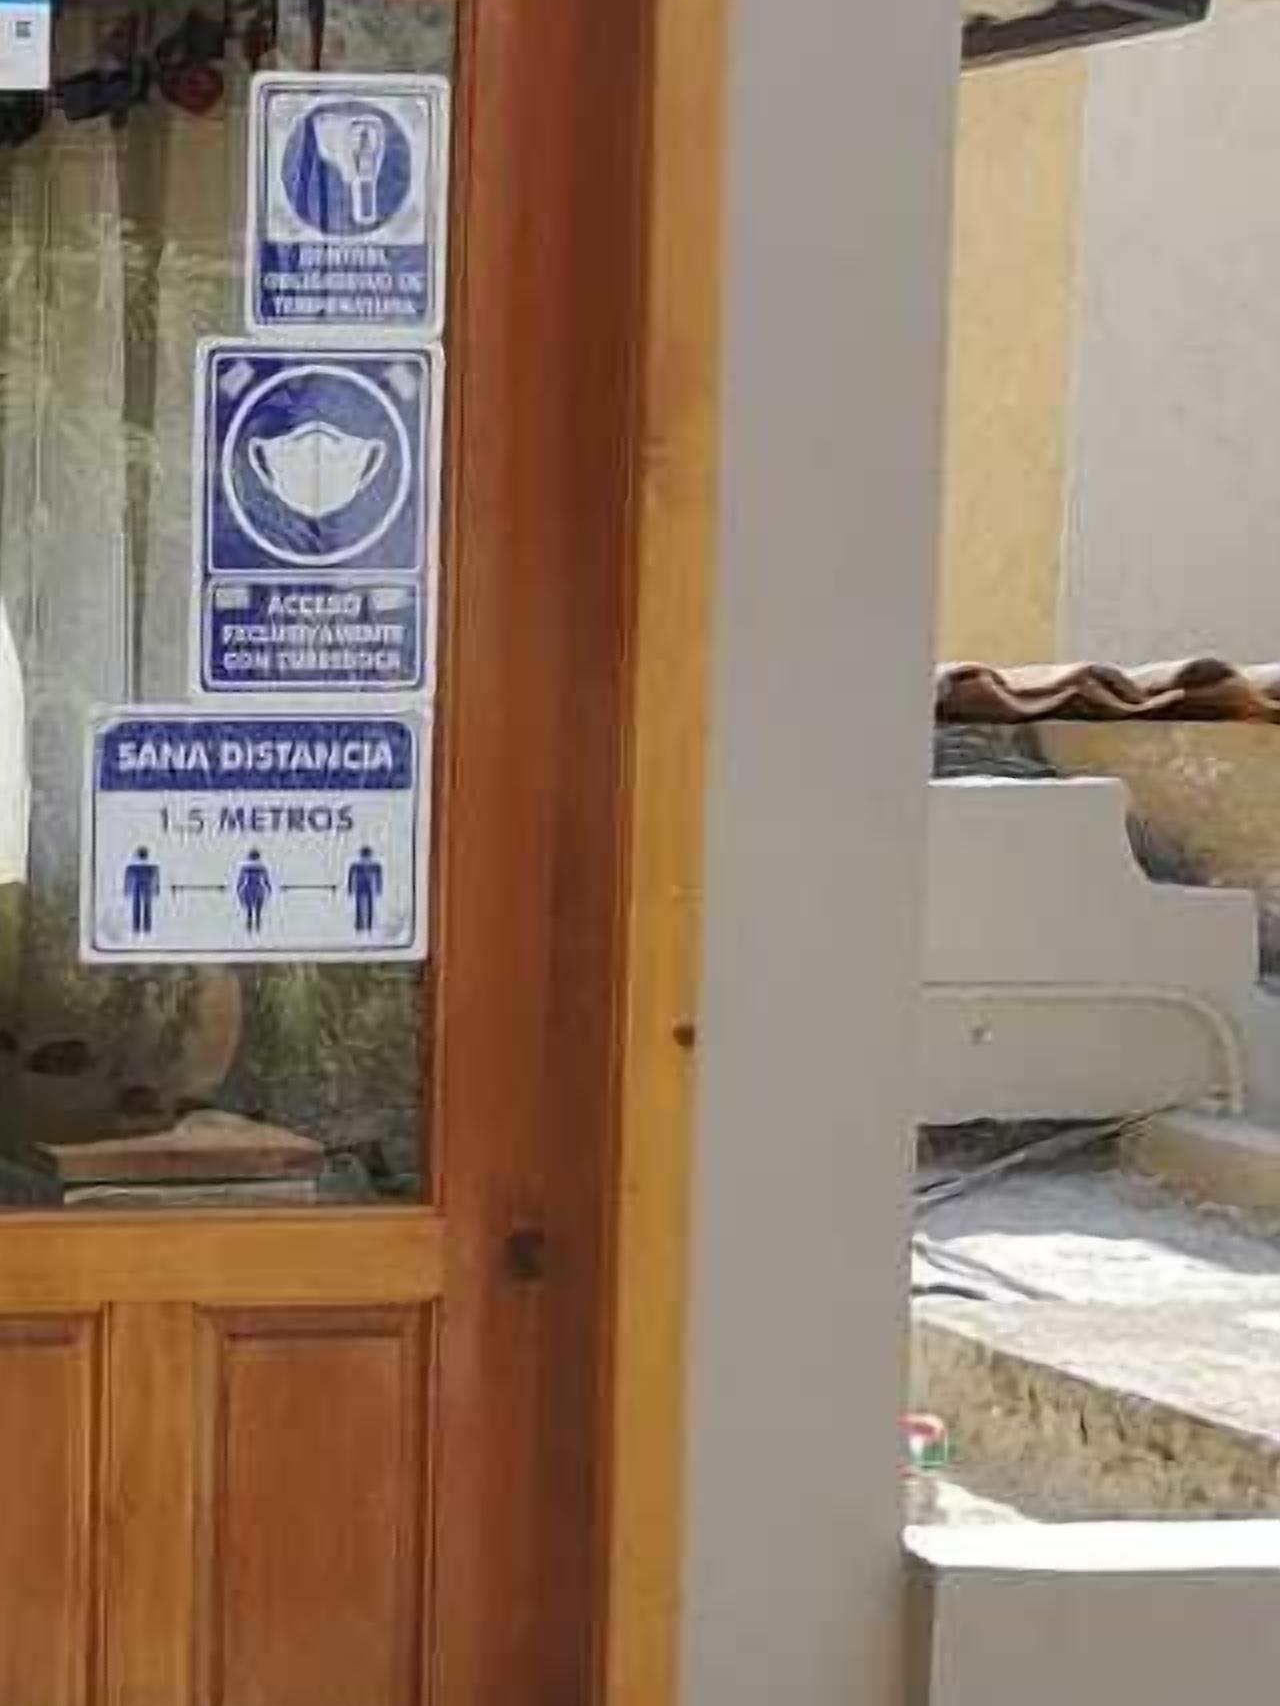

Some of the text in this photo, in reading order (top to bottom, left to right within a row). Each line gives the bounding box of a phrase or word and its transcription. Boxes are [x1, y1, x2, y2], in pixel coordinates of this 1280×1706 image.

[268, 594, 362, 614] ACCESO
[223, 651, 270, 670] CON
[118, 740, 393, 771] SANA DISTANCIA
[159, 805, 354, 833] 1.5 METROS
